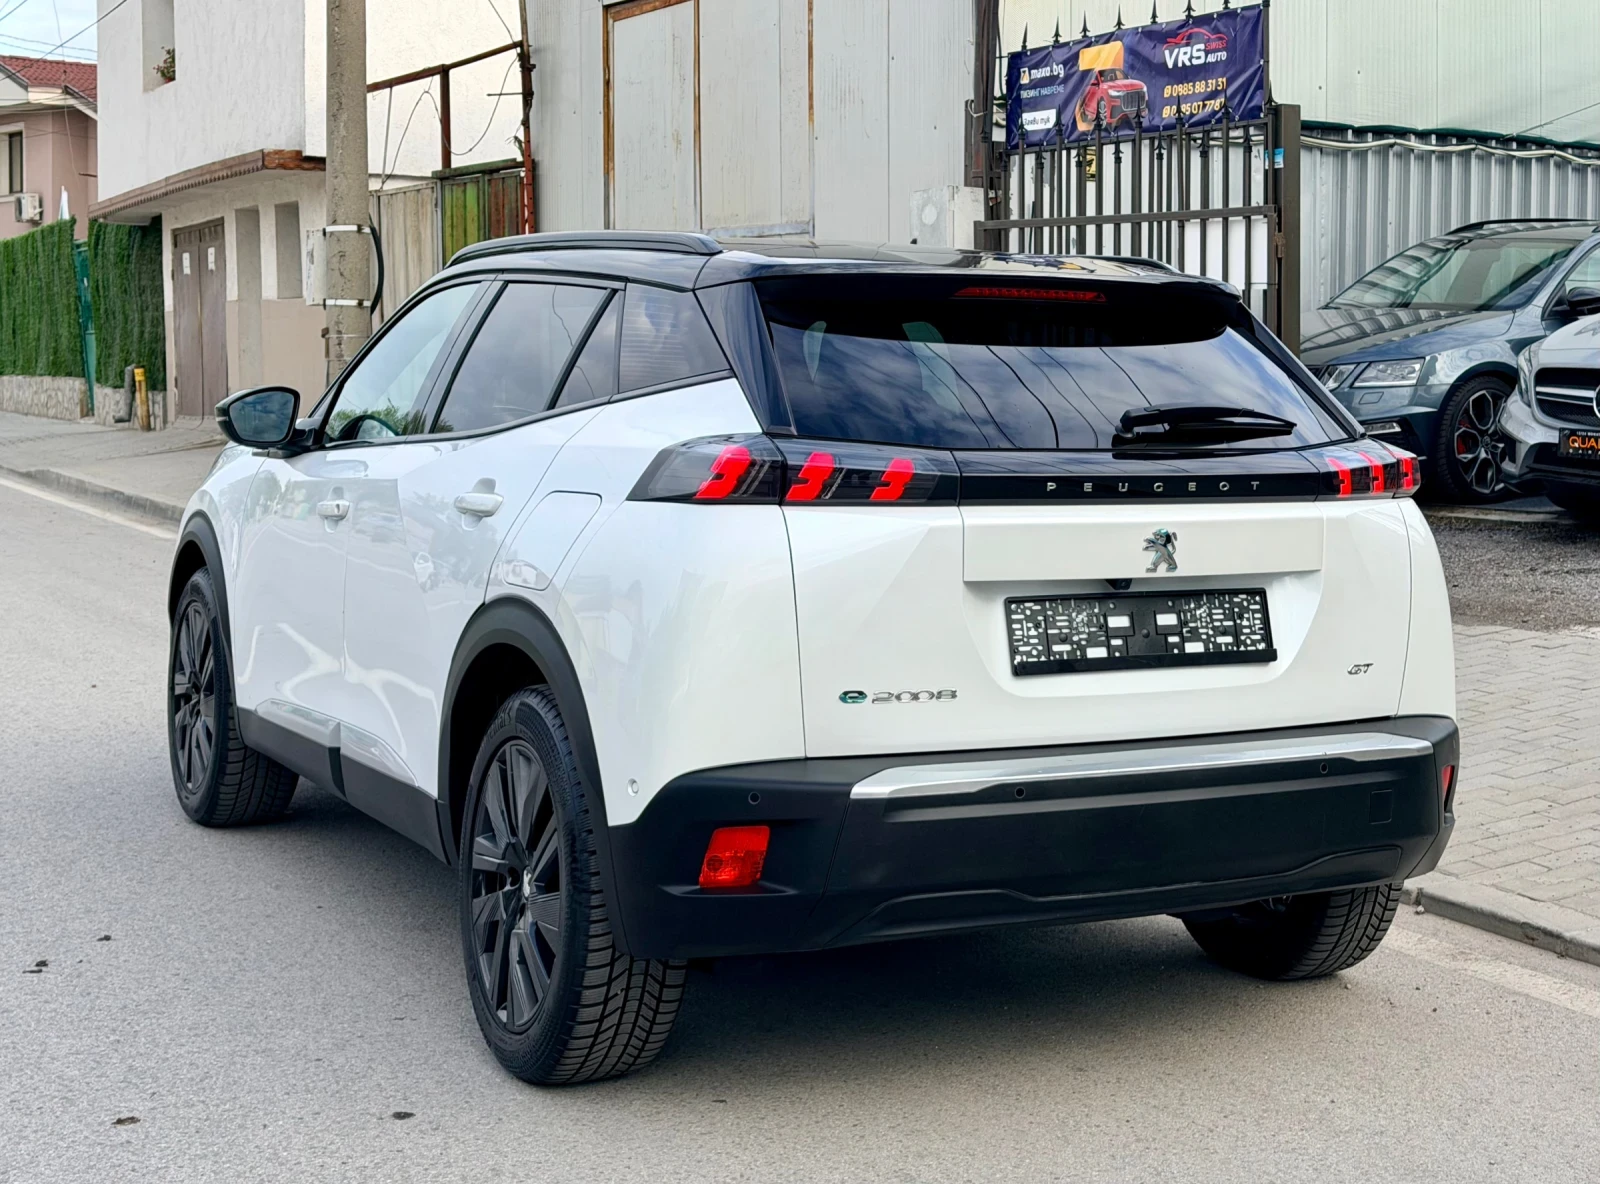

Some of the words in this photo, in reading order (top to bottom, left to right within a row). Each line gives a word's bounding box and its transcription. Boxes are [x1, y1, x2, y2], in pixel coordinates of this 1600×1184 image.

[1205, 40, 1227, 50] SWISS
[1164, 43, 1205, 69] VRS
[1206, 51, 1227, 63] AUTO
[1194, 80, 1206, 93] 88
[1206, 77, 1216, 92] 31
[1217, 76, 1227, 90] 31
[1046, 480, 1261, 493] PEUGEOT
[1347, 662, 1375, 676] GT
[871, 686, 958, 705] 2008
